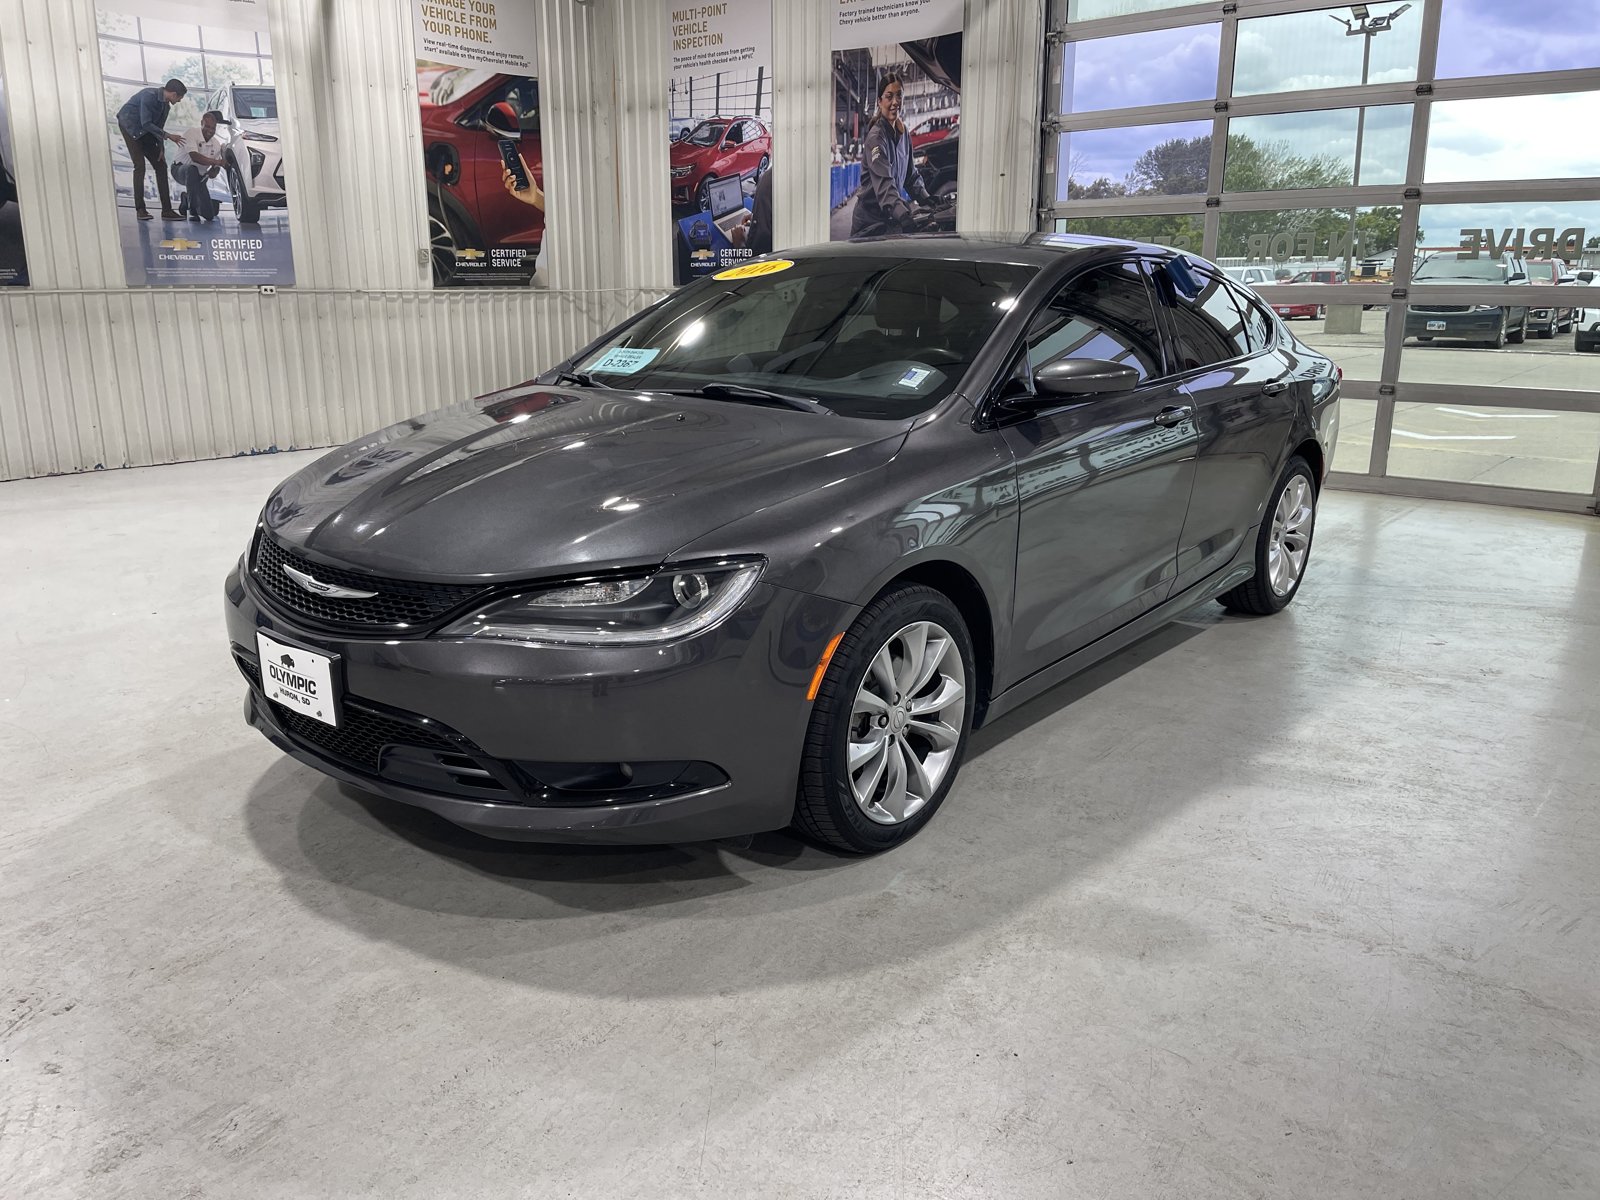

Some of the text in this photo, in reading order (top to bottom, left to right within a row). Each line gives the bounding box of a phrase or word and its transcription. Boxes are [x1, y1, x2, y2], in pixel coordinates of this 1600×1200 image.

[469, 0, 495, 15] YOUR
[876, 3, 904, 12] technicians
[900, 8, 920, 16] anyone.
[421, 4, 497, 30] VEHICLE FROM
[672, 3, 727, 23] MULTI-POINT
[422, 19, 492, 43] YOUR PHONE.
[672, 21, 708, 37] VEHICLE
[673, 33, 723, 51] INSPECTION
[423, 37, 435, 46] View
[436, 41, 459, 50] real-time
[460, 45, 486, 55] diagnostics
[496, 51, 508, 59] enjoy
[439, 49, 459, 57] available
[740, 46, 755, 55] getting
[211, 239, 263, 250] CERTIFIED
[212, 251, 256, 261] SERVICE
[491, 248, 527, 258] CERTIFIED
[720, 248, 753, 257] CERTIFIED
[491, 259, 522, 267] SERVICE
[270, 664, 316, 695] OLYMPIC
[301, 696, 311, 706] SD
